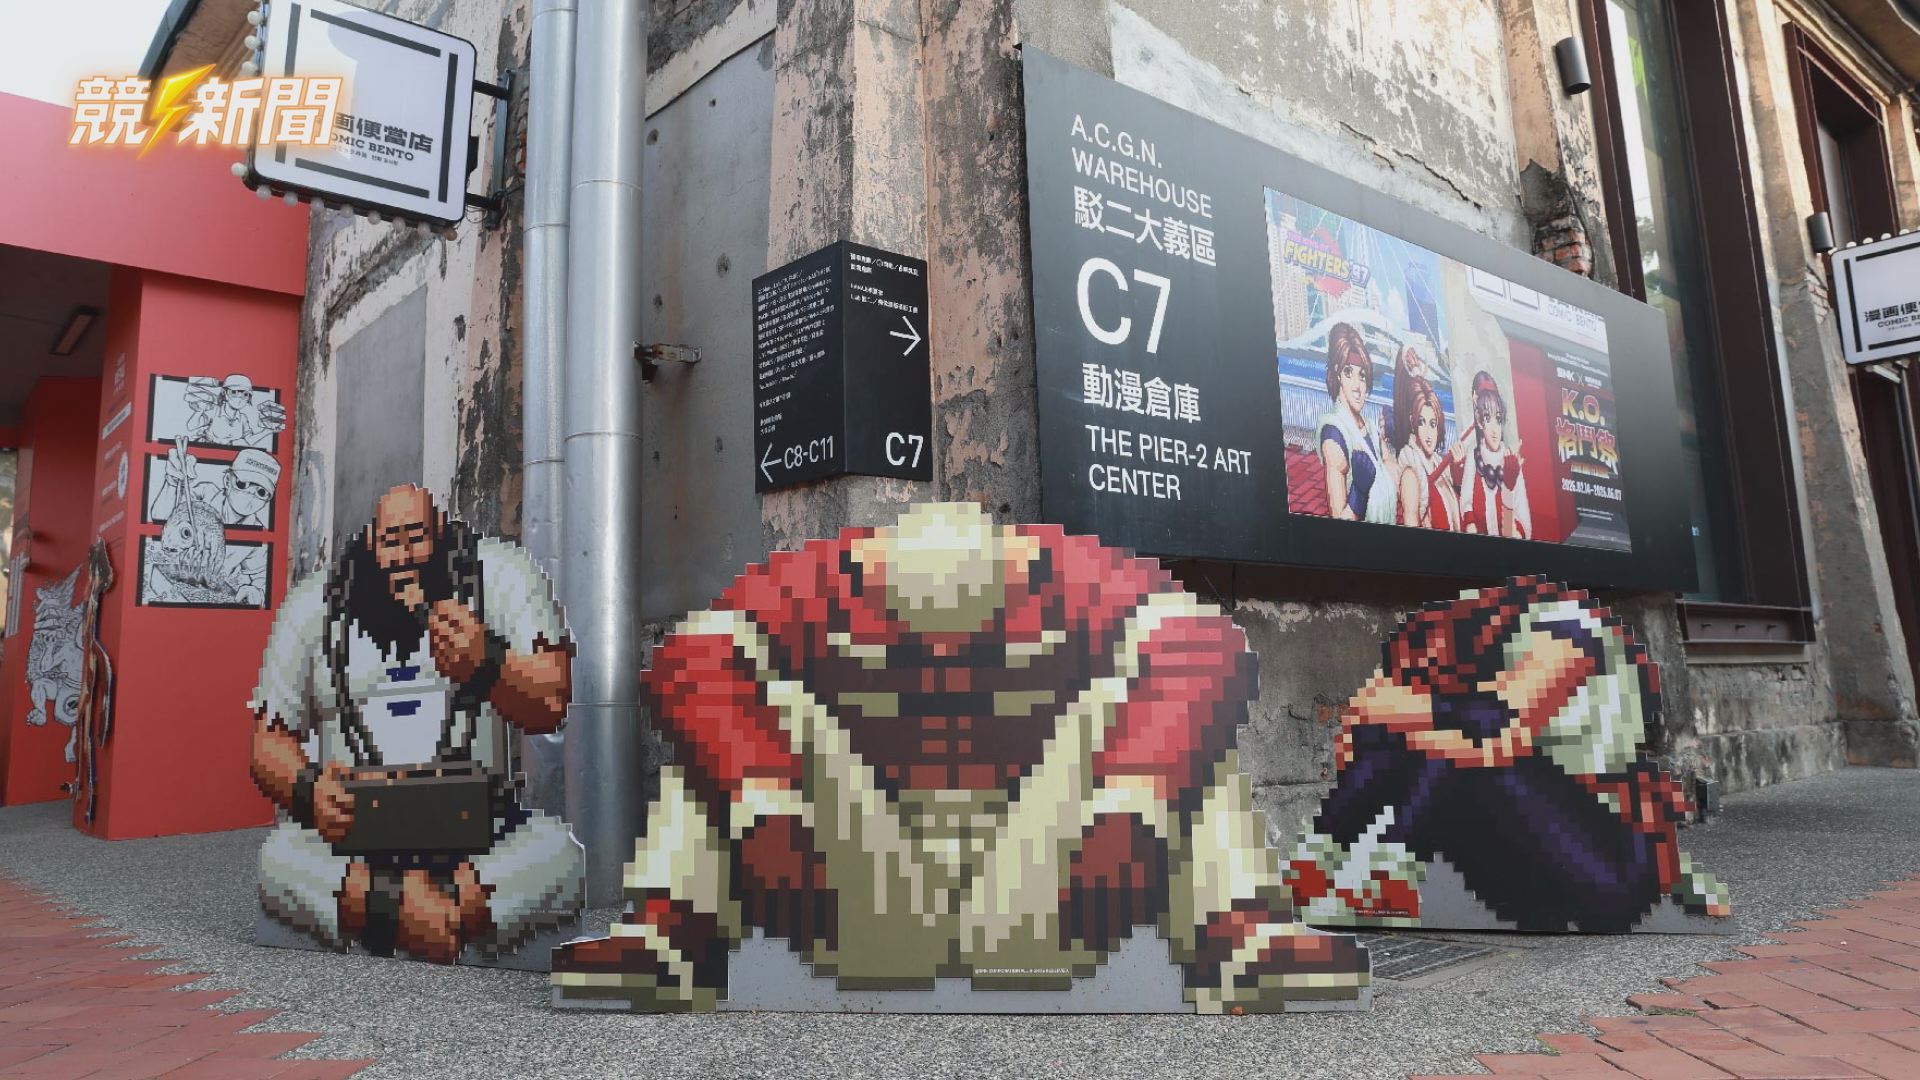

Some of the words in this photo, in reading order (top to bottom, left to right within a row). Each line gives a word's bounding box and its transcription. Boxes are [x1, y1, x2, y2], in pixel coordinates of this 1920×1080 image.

[331, 133, 366, 149] OMIC
[368, 142, 415, 161] BENTO
[334, 112, 434, 154] 画便當店
[1071, 114, 1163, 169] A.C.G.N.
[1072, 147, 1213, 219] WAREHOUSE
[1074, 186, 1217, 267] 駁二大義區
[1284, 240, 1350, 279] FIGHTERS
[1077, 257, 1171, 354] C7
[1864, 300, 1920, 323] 漫画便
[1877, 316, 1909, 328] COMIC
[1082, 363, 1202, 424] 動漫倉庫
[1561, 388, 1606, 426] K.O.
[783, 435, 834, 470] C8-C11
[885, 431, 924, 468] C7
[1085, 424, 1132, 458] THE
[1139, 433, 1208, 469] PIER-2
[1213, 446, 1252, 475] ART
[1088, 463, 1182, 501] CENTER
